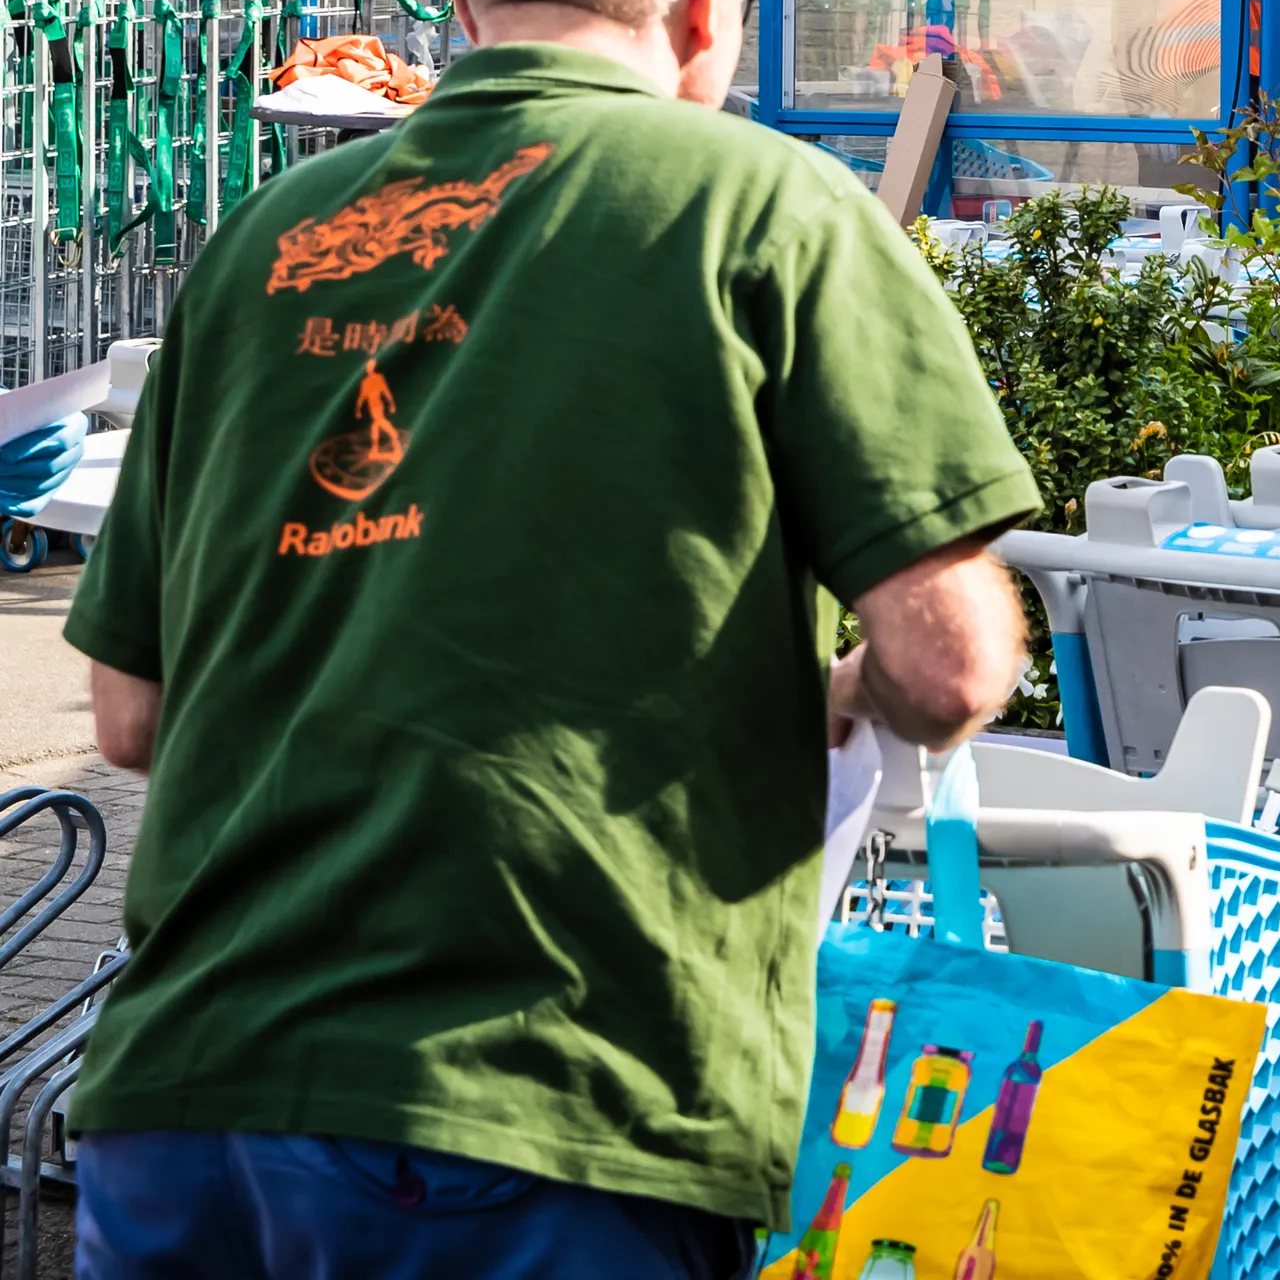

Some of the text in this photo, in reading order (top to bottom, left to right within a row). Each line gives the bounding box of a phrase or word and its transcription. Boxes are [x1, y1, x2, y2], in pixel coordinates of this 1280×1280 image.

[1153, 1056, 1236, 1280] 0% IN DE GLASBAK
